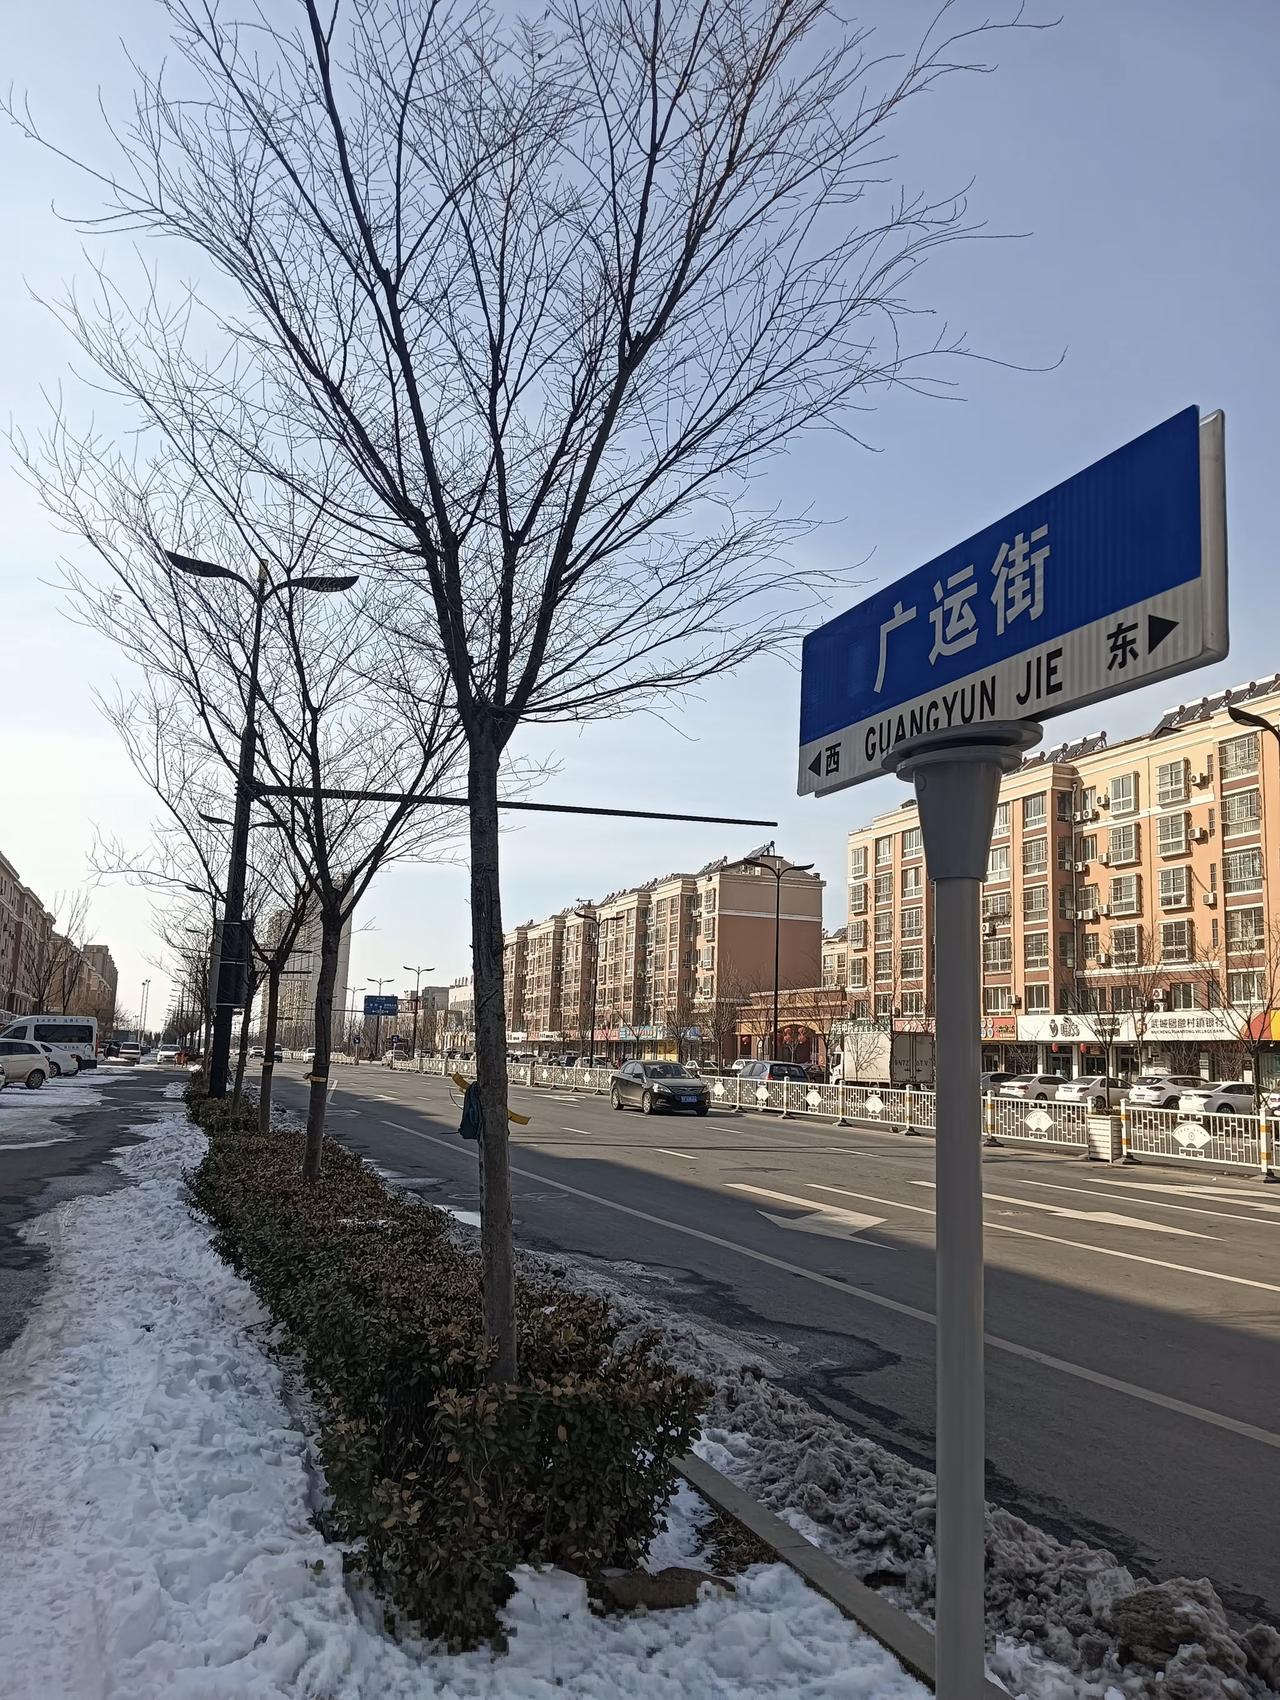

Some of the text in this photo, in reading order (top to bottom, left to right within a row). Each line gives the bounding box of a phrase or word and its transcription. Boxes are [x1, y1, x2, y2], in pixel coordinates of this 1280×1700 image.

[873, 523, 1051, 693] 广运街
[1107, 622, 1140, 671] 东
[865, 647, 1063, 762] GUANGYUN JIE
[825, 741, 842, 776] 西
